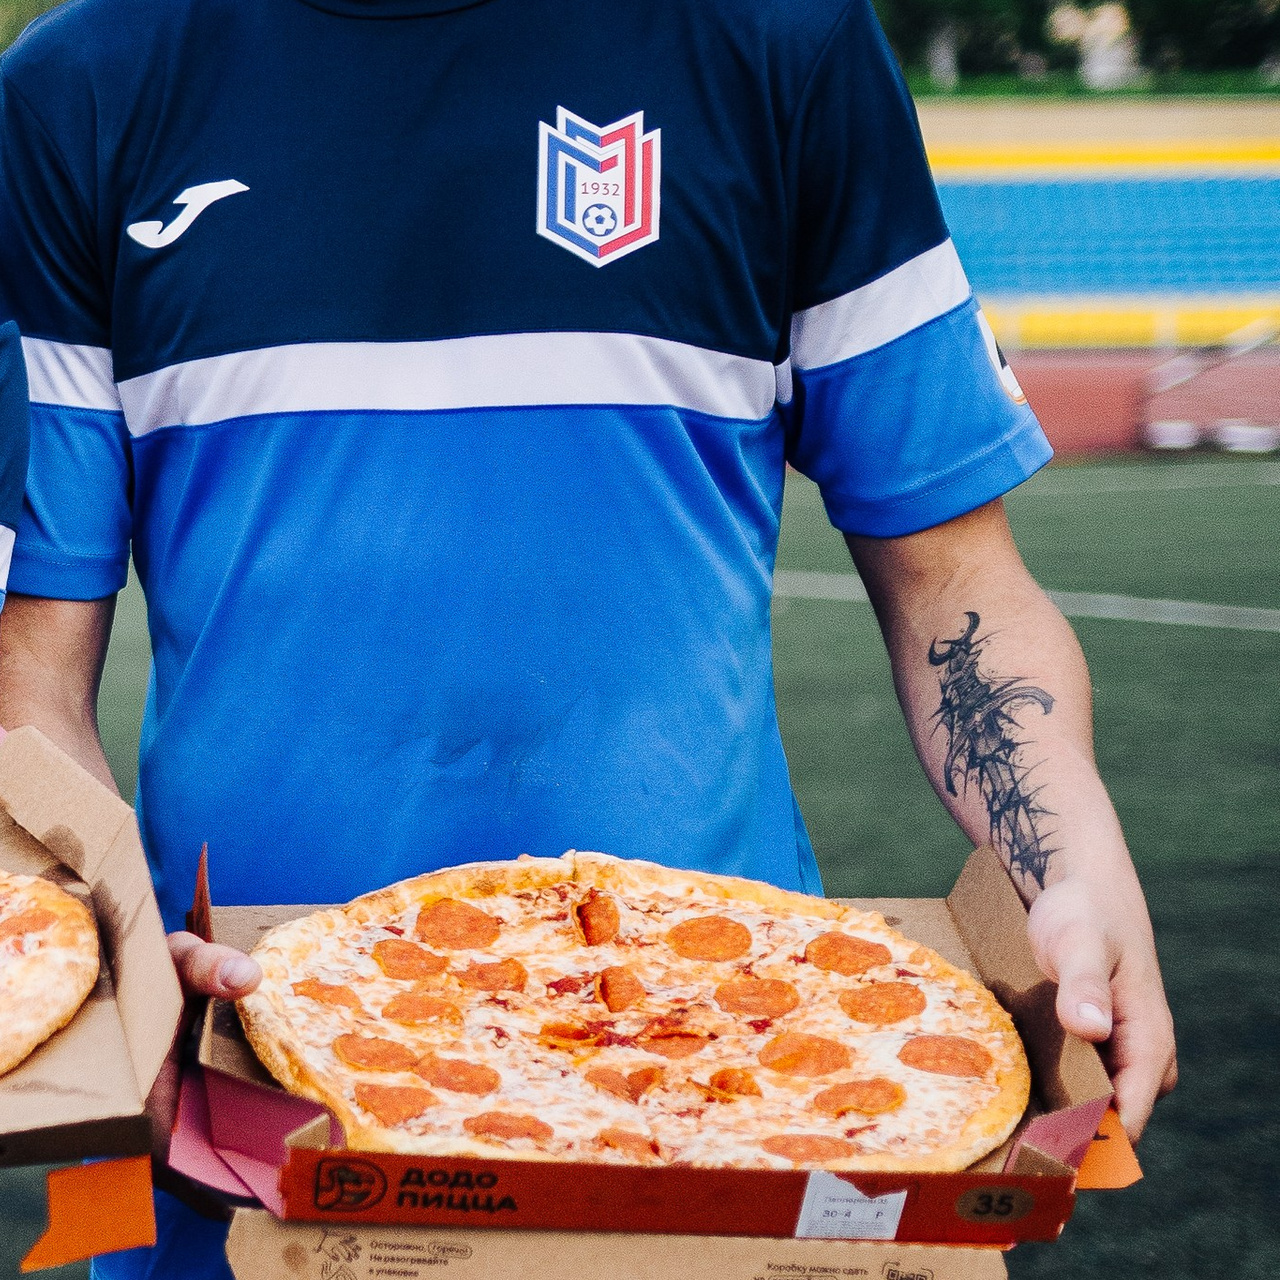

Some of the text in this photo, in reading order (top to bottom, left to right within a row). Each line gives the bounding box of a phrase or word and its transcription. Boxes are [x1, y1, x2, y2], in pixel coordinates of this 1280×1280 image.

[581, 182, 621, 196] 1932
[399, 1167, 499, 1190] ДОДО
[396, 1191, 518, 1214] ПИЦЦА
[973, 1193, 1015, 1217] 35
